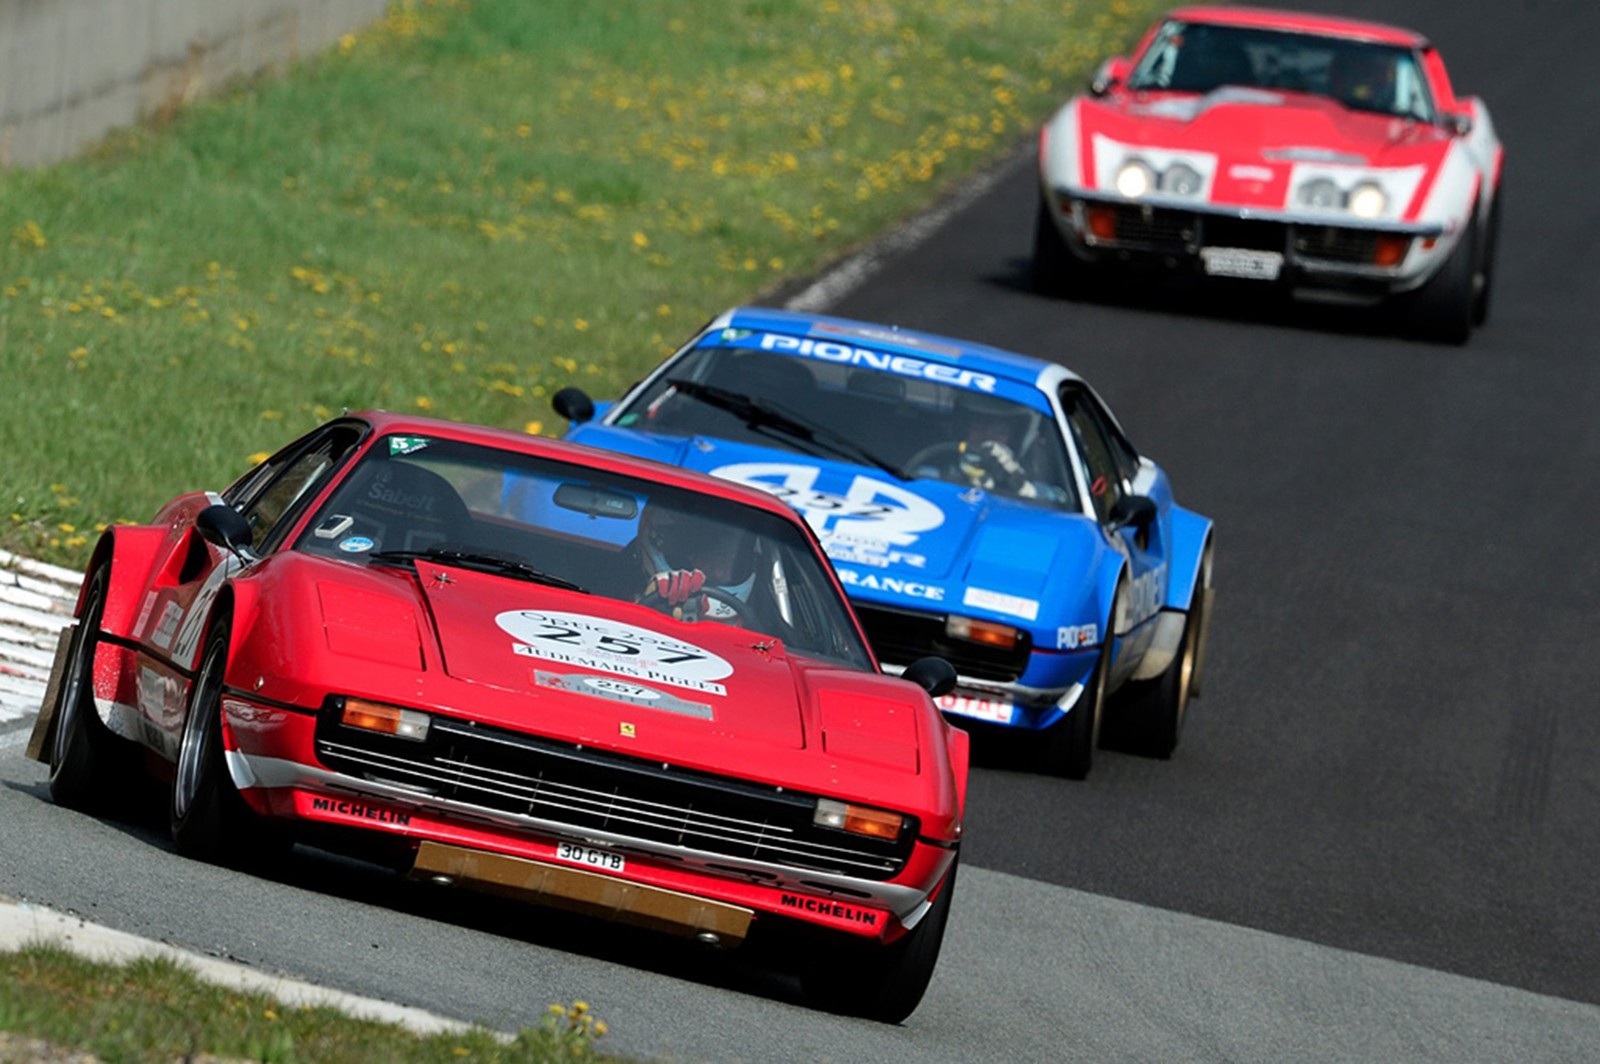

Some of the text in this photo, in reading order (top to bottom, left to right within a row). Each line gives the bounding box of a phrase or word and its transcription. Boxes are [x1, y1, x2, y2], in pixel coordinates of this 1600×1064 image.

[760, 332, 997, 393] PIONEER
[837, 567, 945, 601] RANCE
[520, 611, 701, 653] Optic 2000
[533, 624, 707, 664] 257
[518, 646, 638, 676] AUDEMARS
[648, 671, 723, 693] PIGUET
[598, 680, 645, 696] 257
[940, 693, 1009, 721] OTAL
[312, 798, 410, 826] MICHELIN
[559, 845, 623, 870] 30 GTB
[781, 894, 876, 925] MICHELIN
